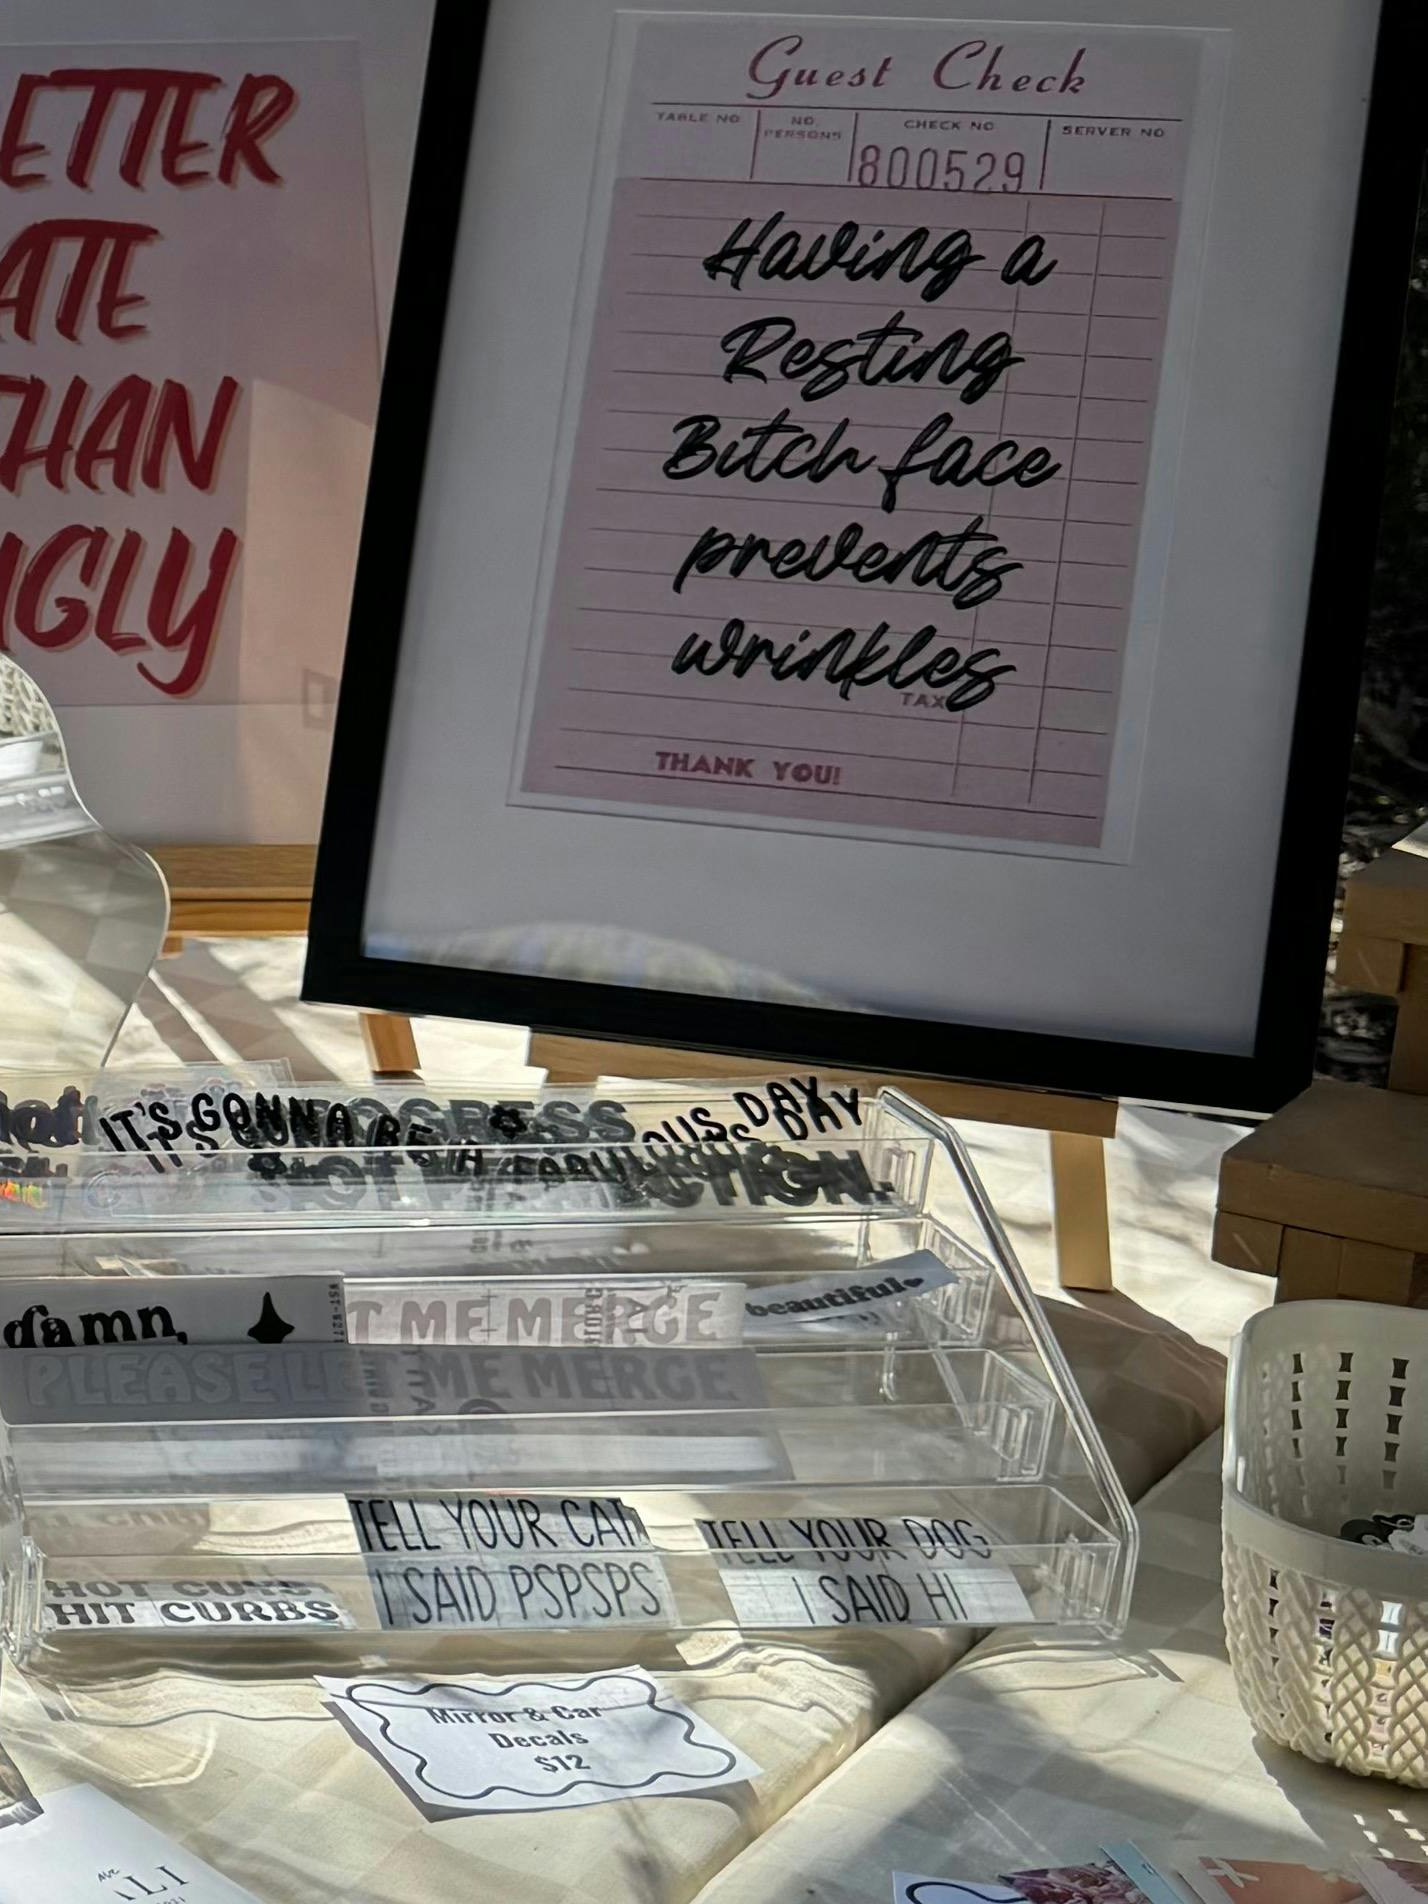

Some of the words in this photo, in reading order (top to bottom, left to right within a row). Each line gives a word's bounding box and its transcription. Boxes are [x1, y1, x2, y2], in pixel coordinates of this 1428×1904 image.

[747, 34, 892, 99] Guest
[933, 39, 1087, 94] Check
[656, 111, 709, 123] TABLE
[764, 129, 841, 141] PERSONS
[904, 119, 962, 132] CHECK
[1062, 125, 1132, 138] SERVER
[858, 145, 1025, 192] 800529
[703, 211, 986, 301] Having
[1000, 230, 1058, 286] a
[720, 311, 1025, 404] Resting
[663, 408, 877, 484] Bitch
[879, 412, 1061, 512] face
[673, 516, 1023, 609] prevents
[671, 617, 1016, 712] wrinkles
[900, 692, 945, 710] TAX
[655, 750, 754, 779] THANK
[773, 760, 841, 786] YOU!
[506, 1292, 722, 1346] MERGE
[745, 1276, 901, 1318] beautiful
[522, 1351, 737, 1402] MERGE
[349, 1498, 441, 1552] TELL
[440, 1497, 558, 1551] YOUR
[573, 1497, 641, 1548] CAT
[703, 1520, 795, 1563] TELL
[790, 1519, 907, 1562] YOUR
[902, 1518, 992, 1559] DOG
[47, 1602, 135, 1625] HIT
[160, 1600, 340, 1624] CURBS
[413, 1566, 499, 1624] SAID
[511, 1562, 664, 1620] PSPSPS
[792, 1576, 815, 1624] I
[819, 1574, 911, 1624] SAID
[916, 1572, 969, 1621] HI
[551, 1706, 602, 1720] Car
[488, 1730, 589, 1749] Decals
[534, 1754, 591, 1774] $12
